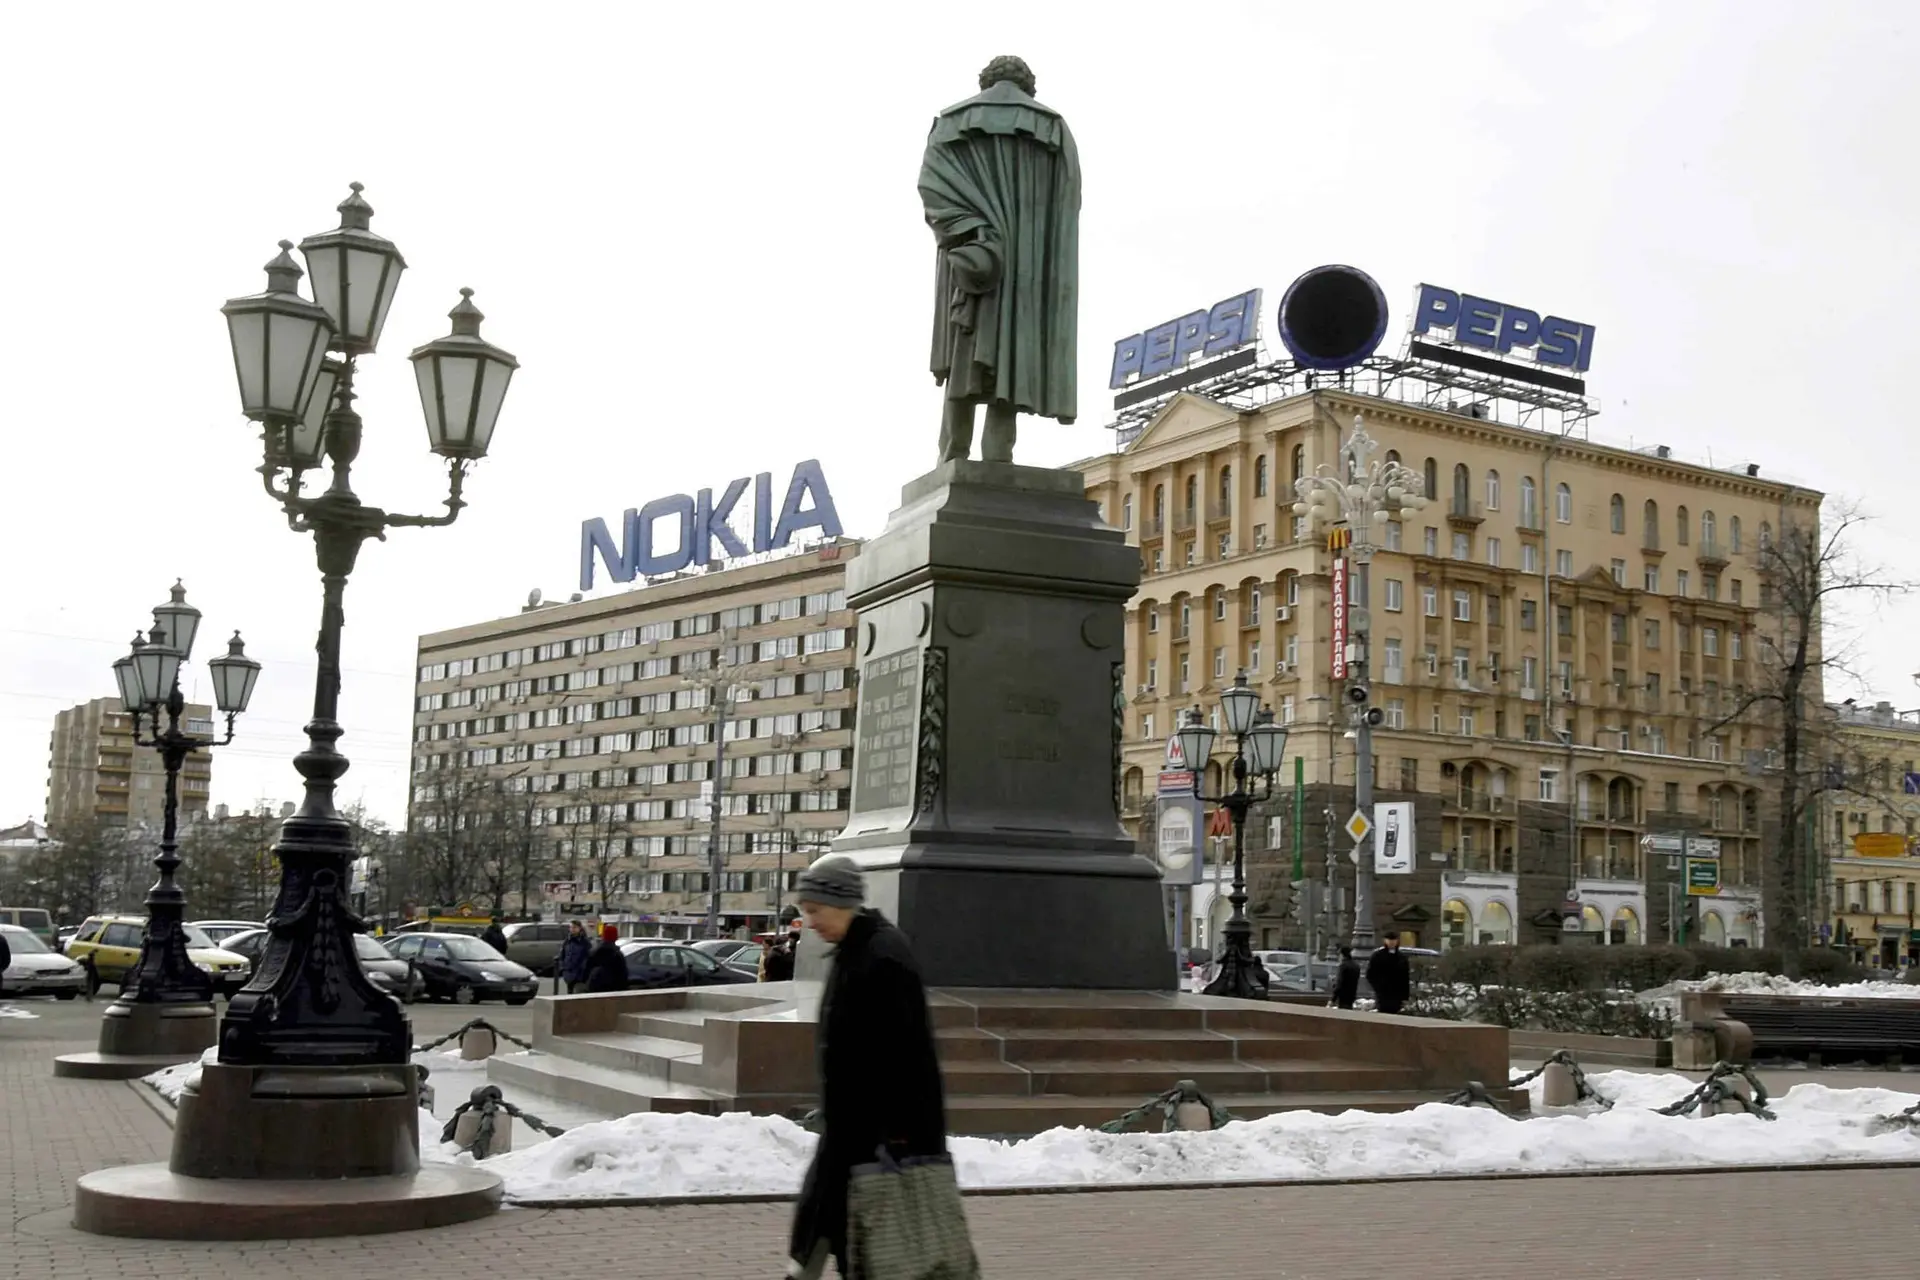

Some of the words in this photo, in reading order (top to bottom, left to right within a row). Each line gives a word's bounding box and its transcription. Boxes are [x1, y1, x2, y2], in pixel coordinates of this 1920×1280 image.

[1109, 288, 1262, 390] PEPSI
[1414, 282, 1596, 372] PEPSI
[580, 458, 844, 591] NOKIA
[1333, 558, 1344, 678] МАКДОНАЛДС
